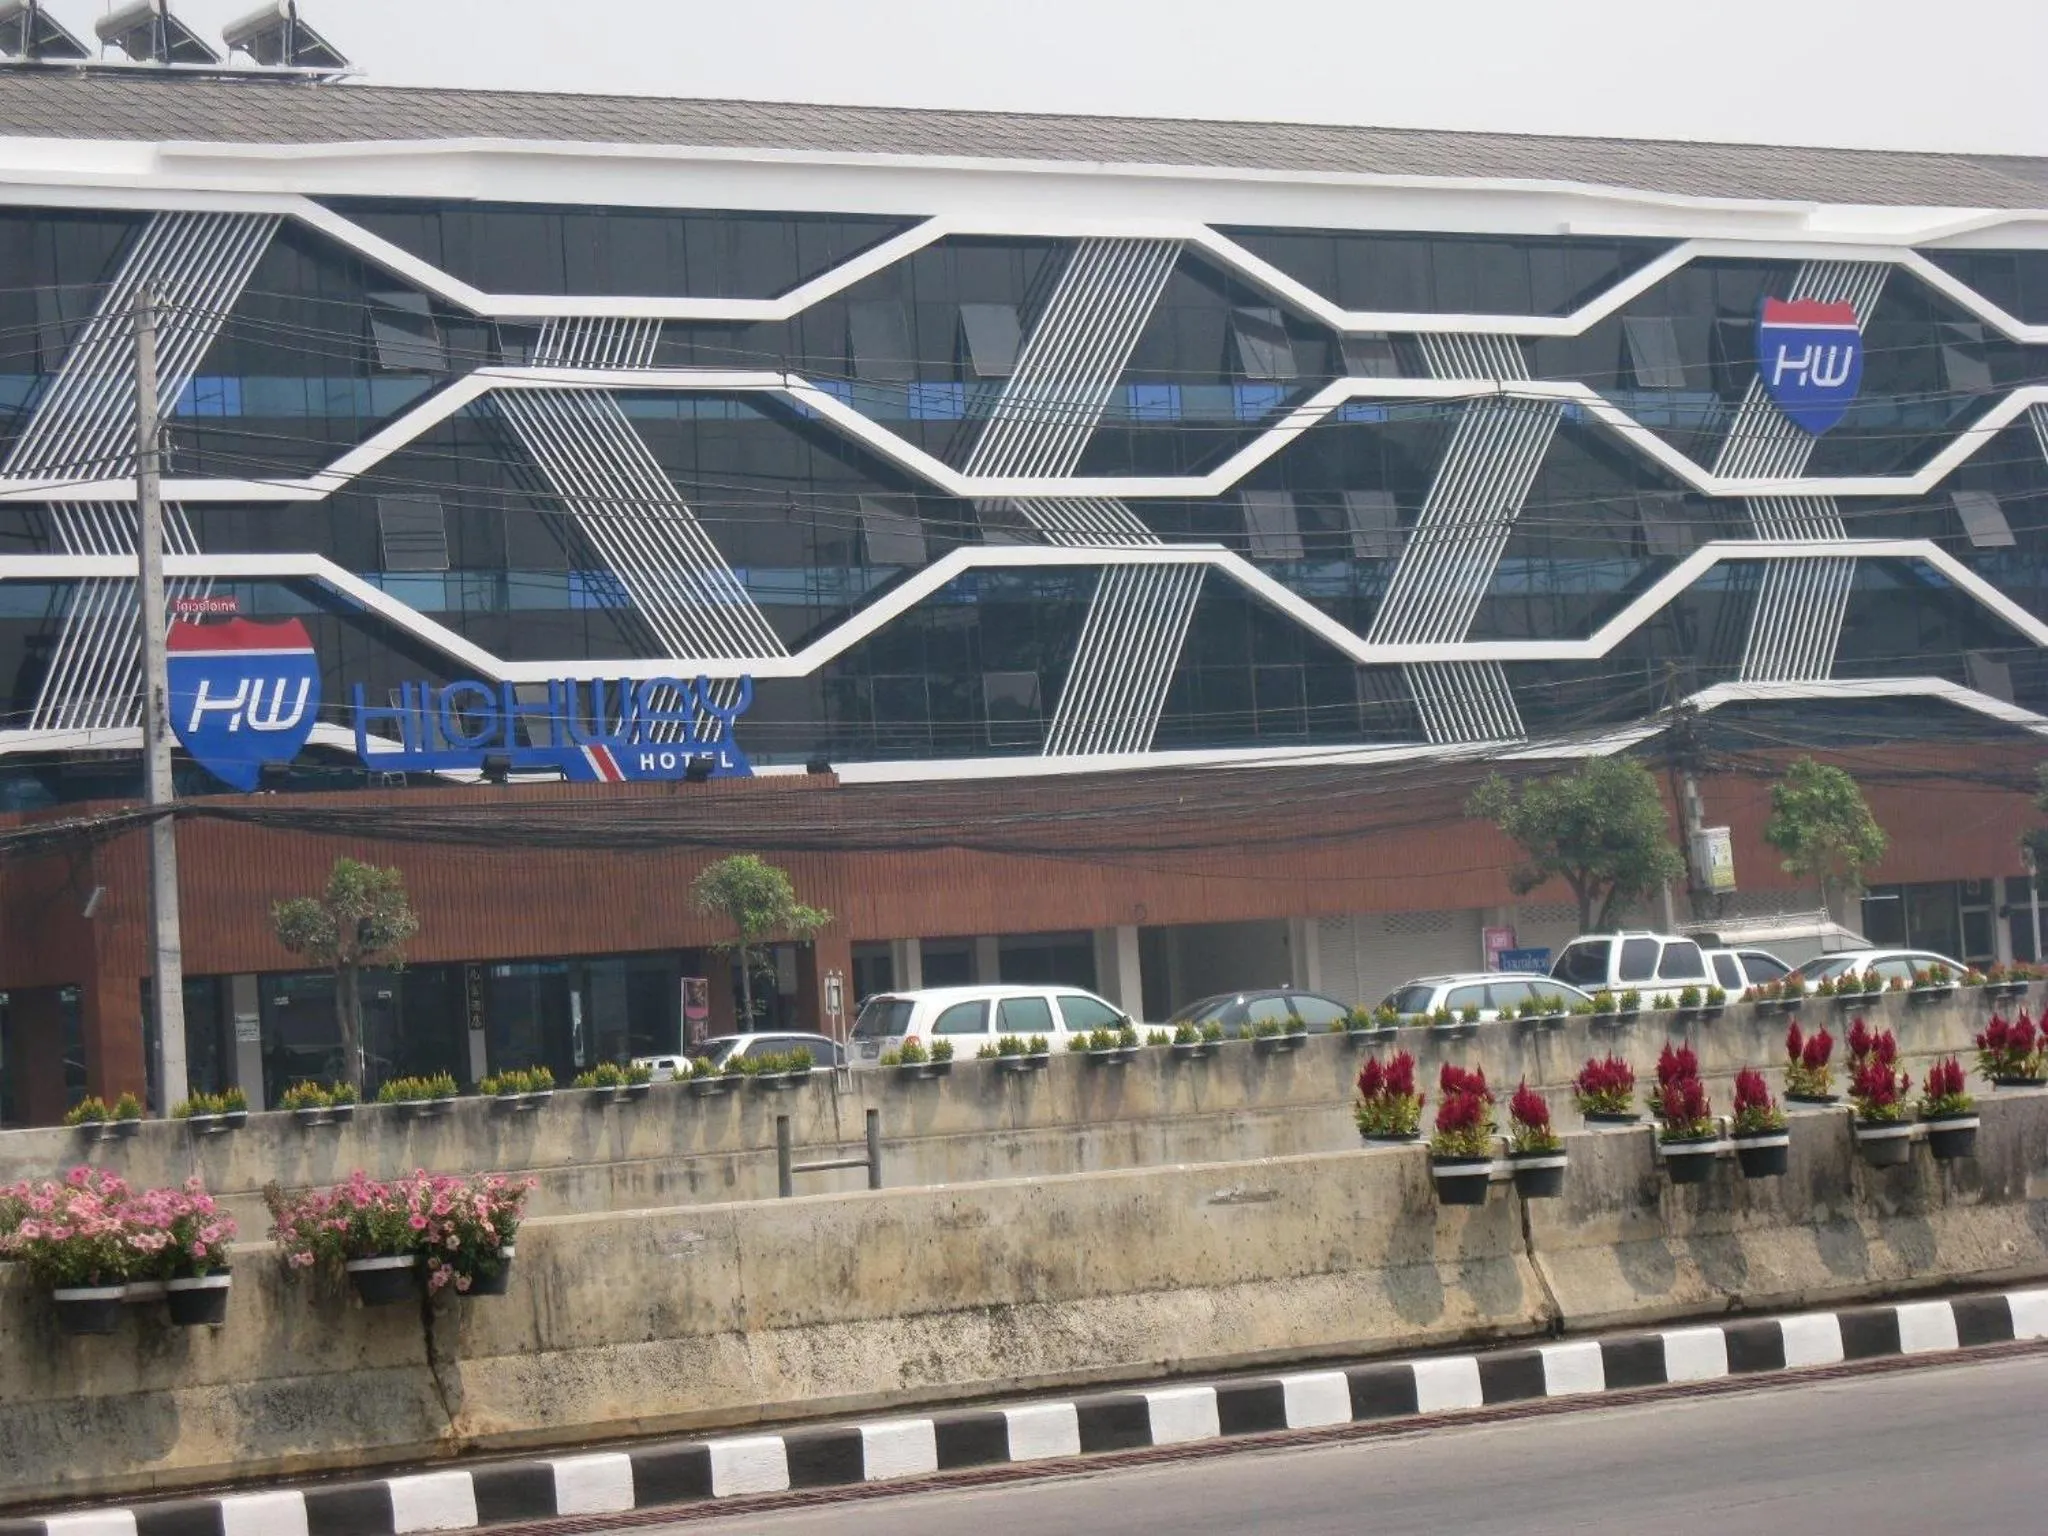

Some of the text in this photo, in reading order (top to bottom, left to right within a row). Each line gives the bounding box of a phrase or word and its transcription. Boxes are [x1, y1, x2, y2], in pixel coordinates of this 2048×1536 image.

[1772, 344, 1853, 387] HW
[187, 677, 311, 733] HW
[353, 674, 753, 754] HIGHWAY
